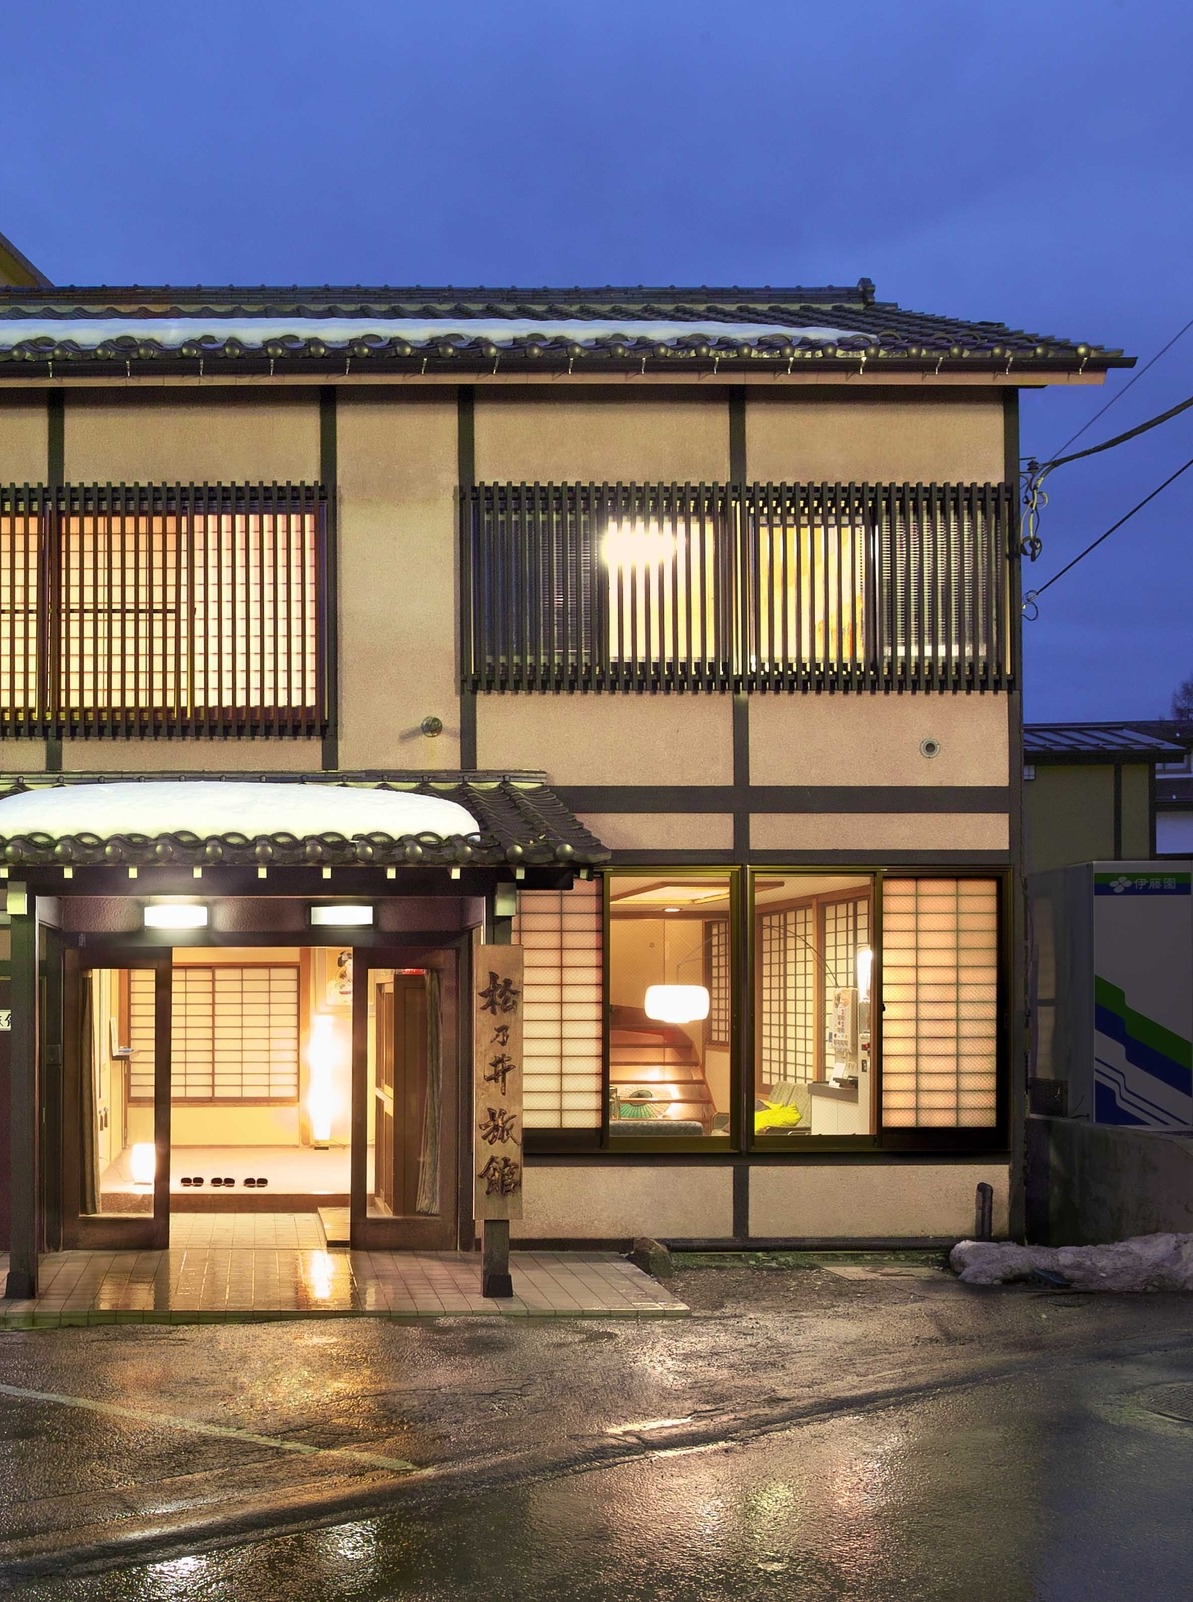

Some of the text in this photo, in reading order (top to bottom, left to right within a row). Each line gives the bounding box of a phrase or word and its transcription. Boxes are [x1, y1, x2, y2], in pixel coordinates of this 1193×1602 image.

[1134, 878, 1176, 890] 伊藤園
[477, 971, 522, 1195] 松乃井旅館
